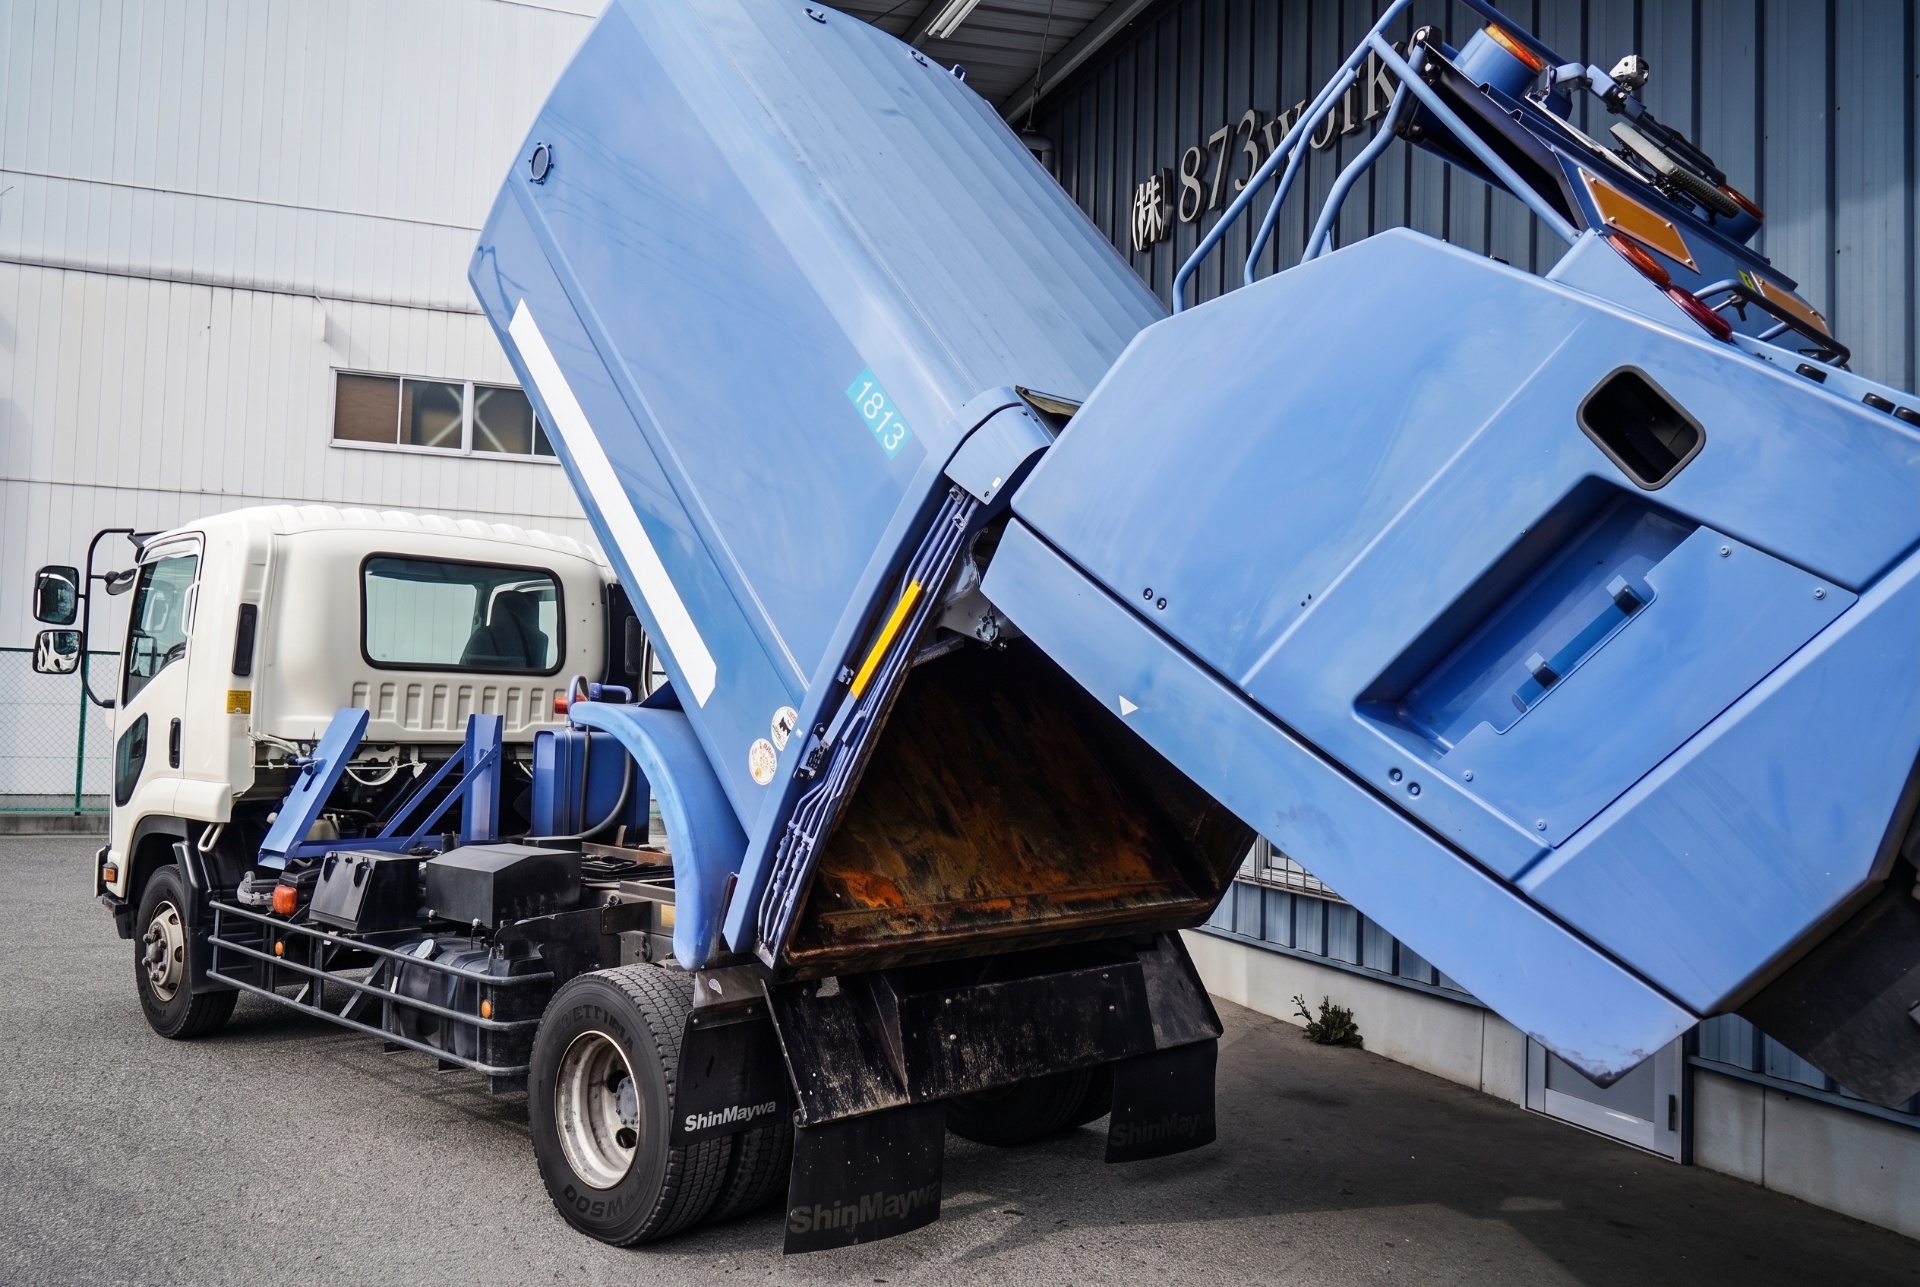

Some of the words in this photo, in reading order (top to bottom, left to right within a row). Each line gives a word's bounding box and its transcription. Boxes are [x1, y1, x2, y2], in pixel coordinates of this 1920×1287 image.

[856, 381, 905, 450] 1813
[684, 1101, 776, 1132] ShinMaywa
[788, 1181, 940, 1234] ShinMaywa
